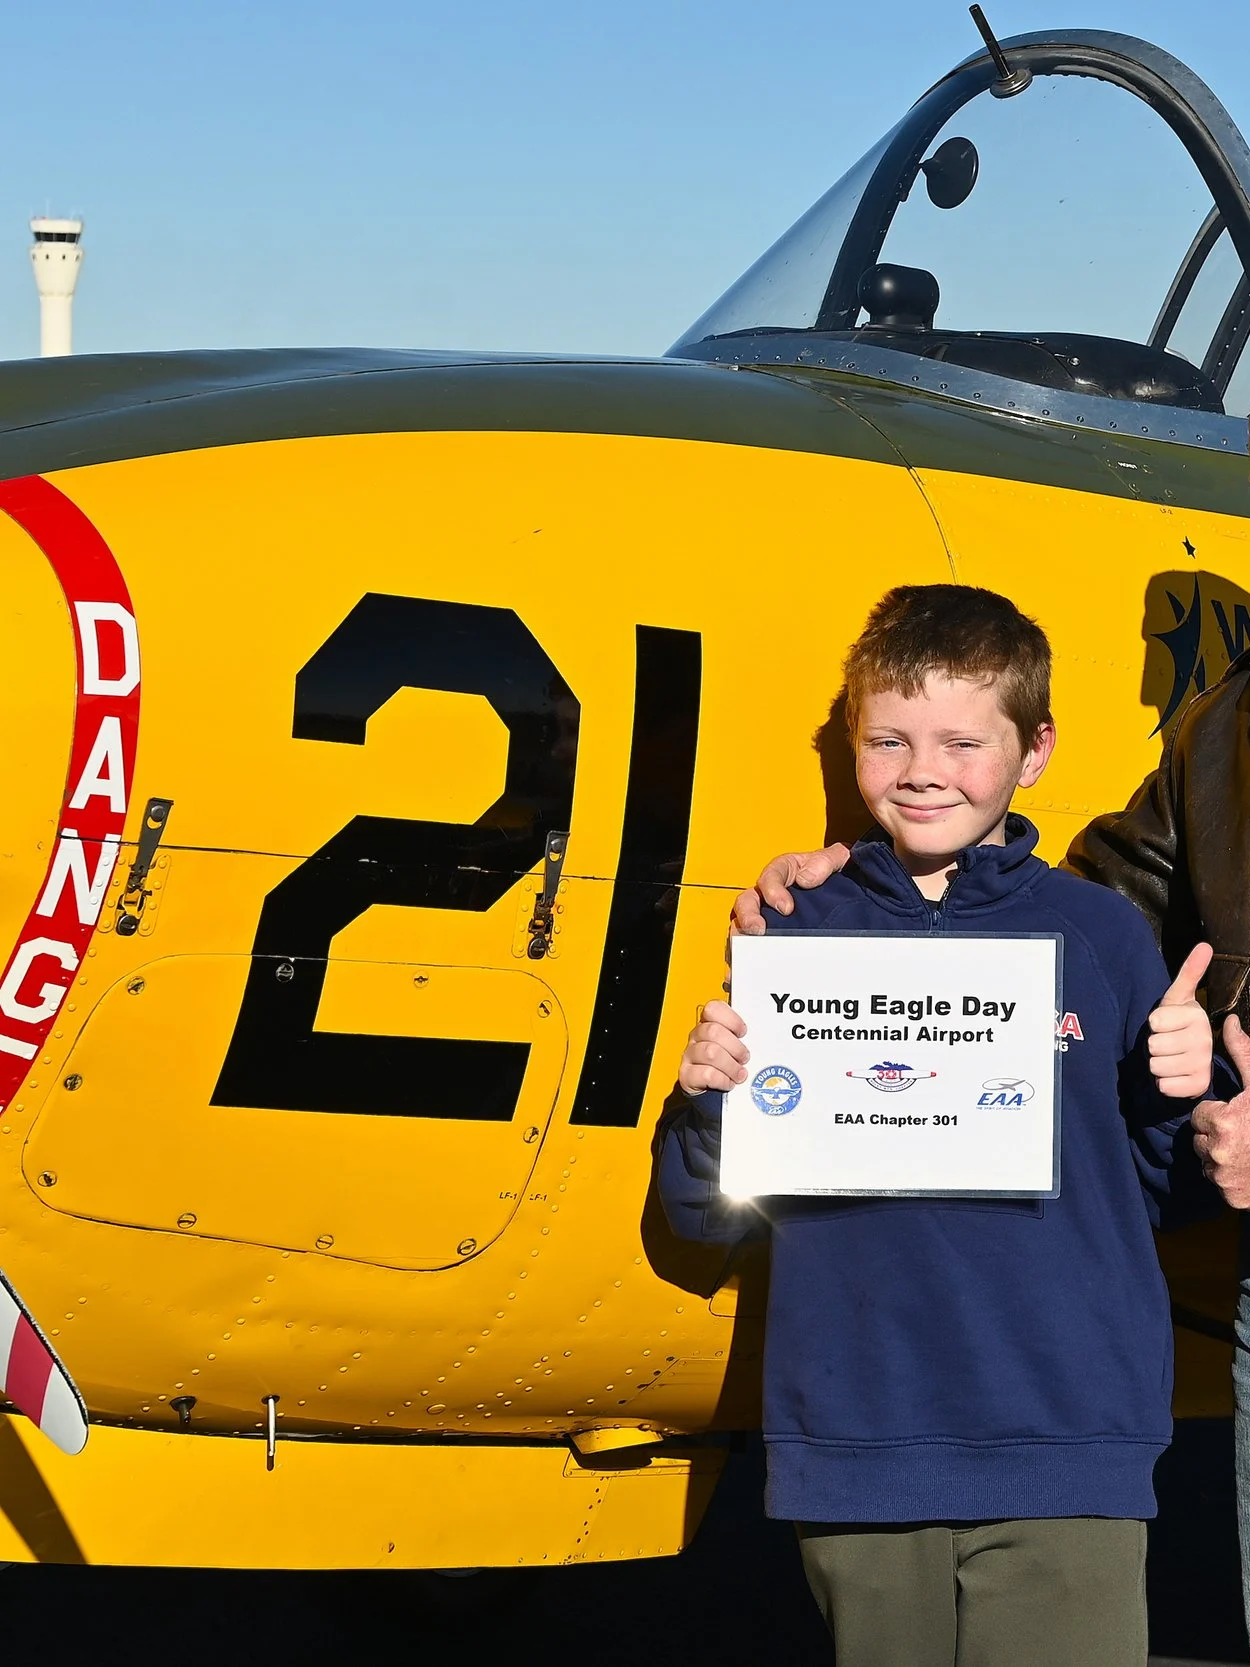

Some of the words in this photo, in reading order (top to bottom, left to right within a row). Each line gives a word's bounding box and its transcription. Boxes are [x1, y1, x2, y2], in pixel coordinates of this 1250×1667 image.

[210, 593, 702, 1127] 21
[770, 993, 859, 1020] Young
[870, 994, 952, 1021] Eagle
[962, 995, 1017, 1022] Day
[791, 1024, 909, 1041] Centennial
[916, 1026, 994, 1046] Airport
[755, 1068, 776, 1085] YOUNG
[977, 1093, 1023, 1106] EAA
[834, 1113, 865, 1125] EAA
[869, 1114, 928, 1128] Chapter
[932, 1115, 958, 1126] 301
[499, 1192, 518, 1200] LF-1
